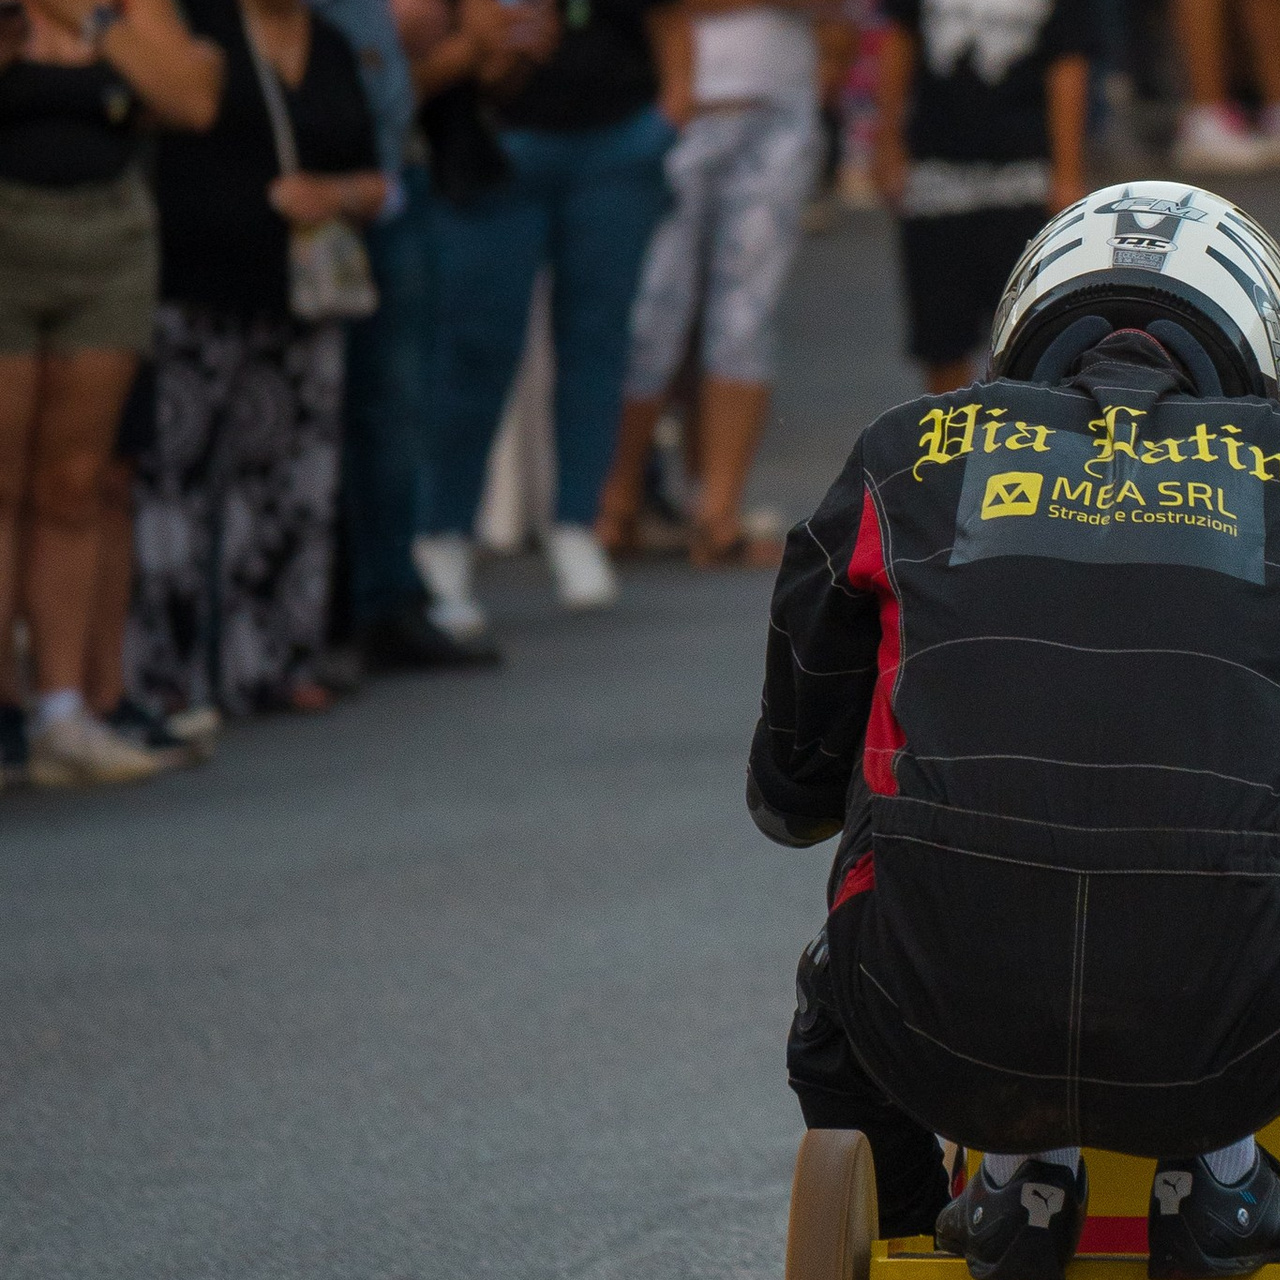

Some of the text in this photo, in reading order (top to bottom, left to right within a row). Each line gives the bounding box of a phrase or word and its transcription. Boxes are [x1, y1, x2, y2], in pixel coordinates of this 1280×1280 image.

[912, 403, 1057, 482] Via
[1051, 476, 1238, 520] MEA SRL
[1048, 504, 1239, 537] Strade e Costruzioni
